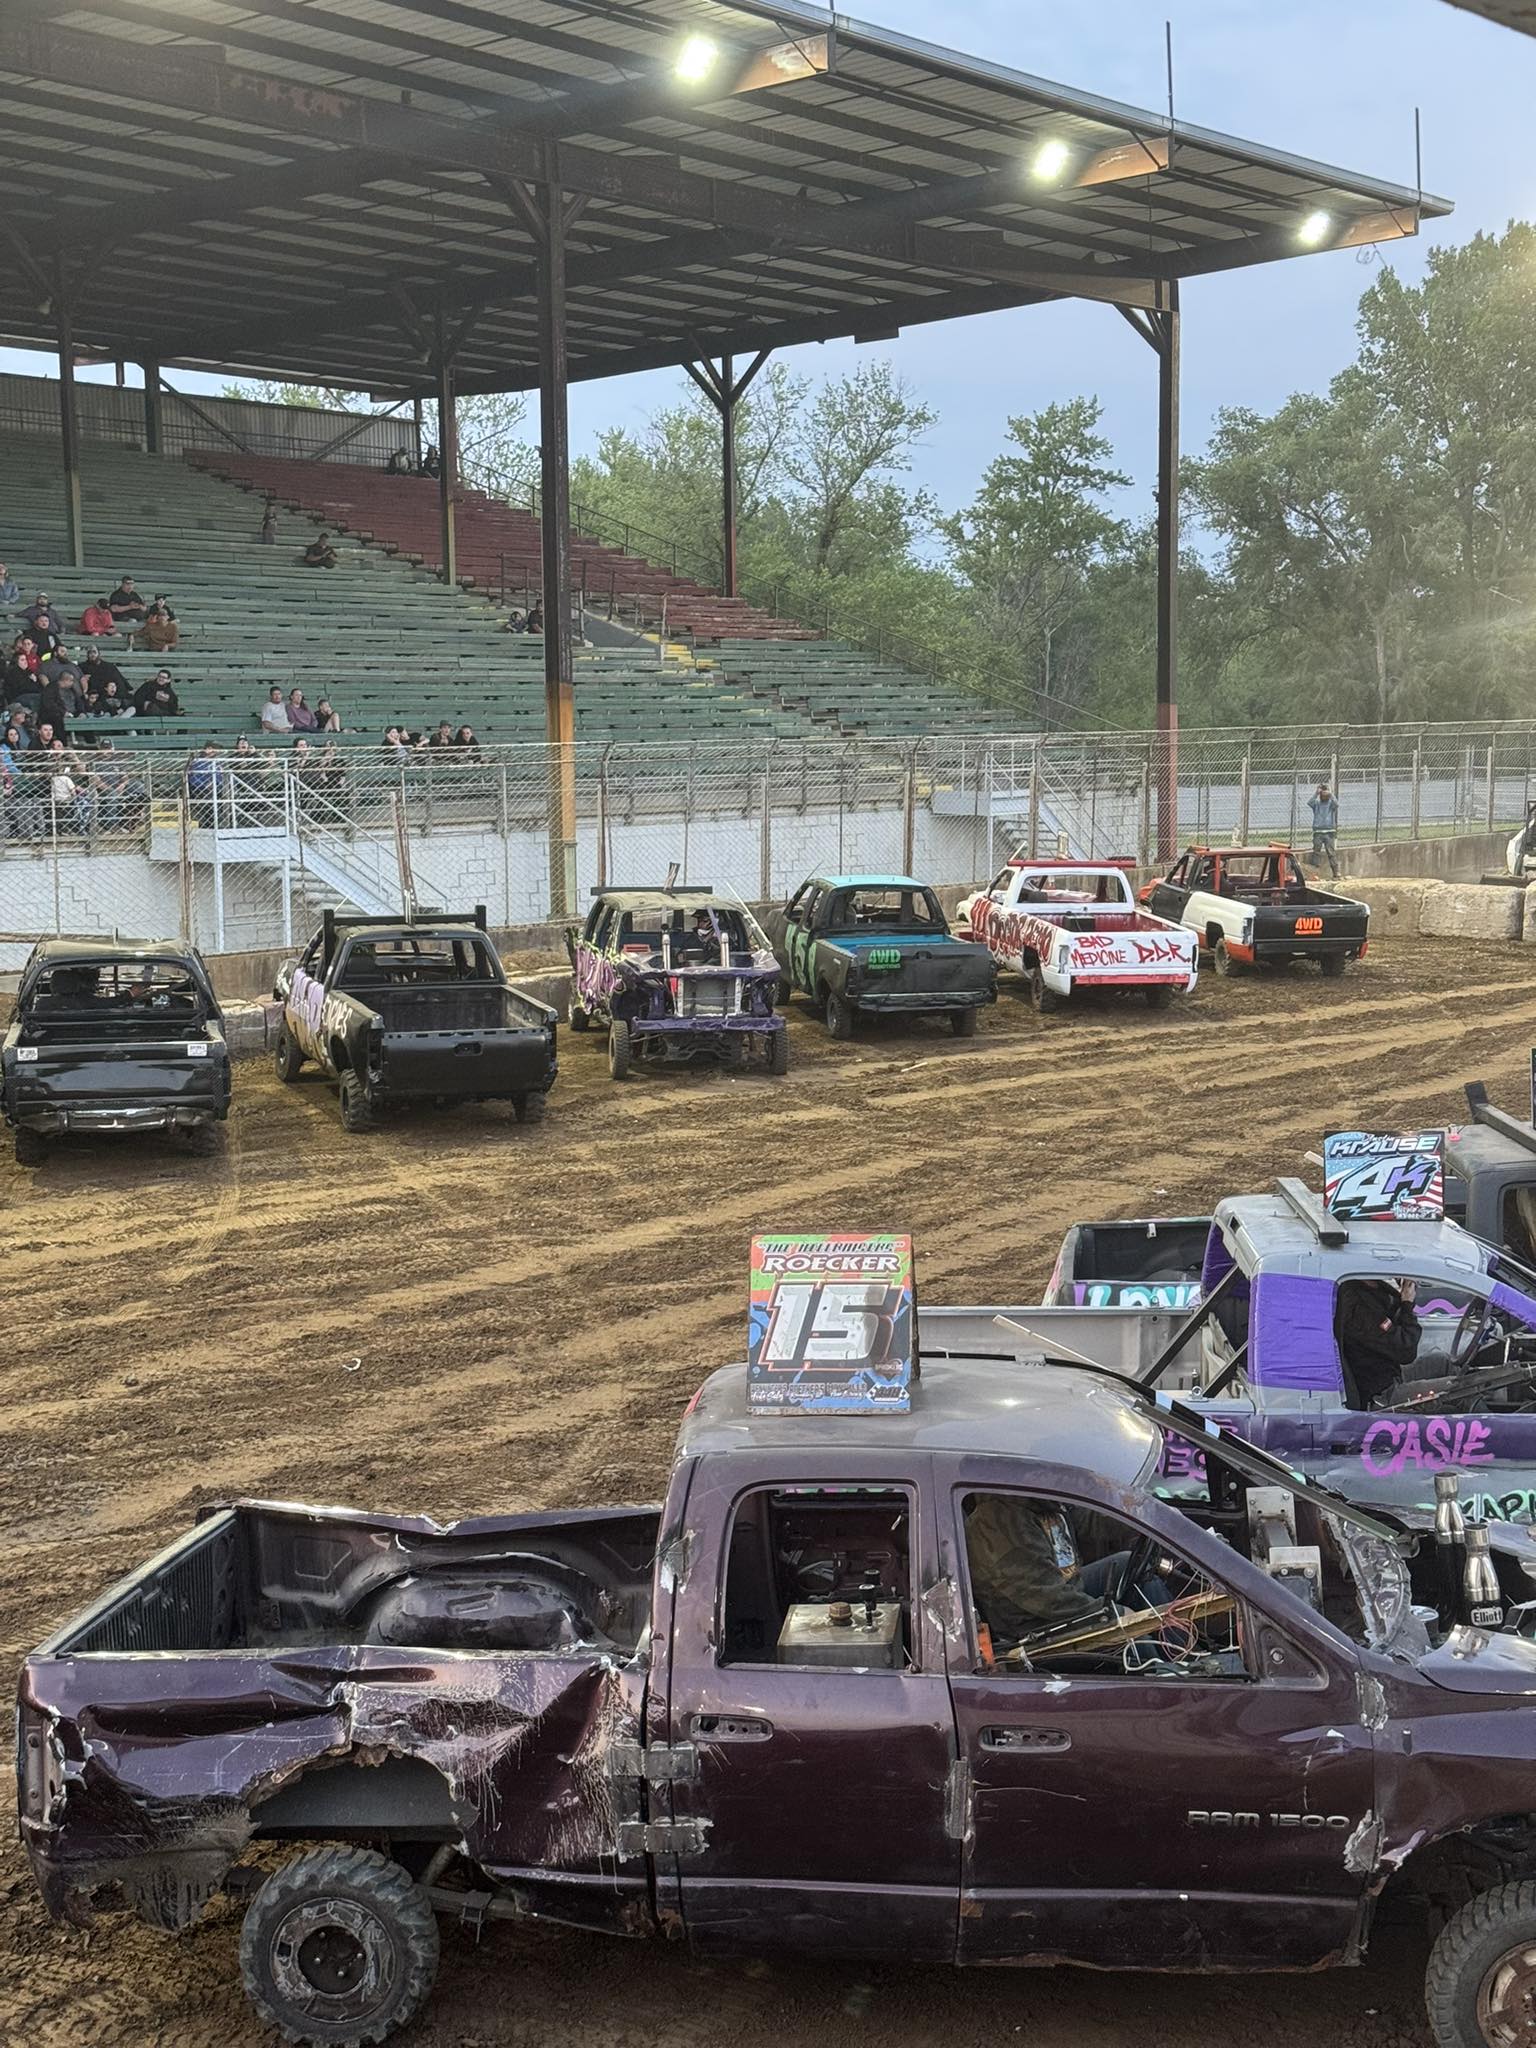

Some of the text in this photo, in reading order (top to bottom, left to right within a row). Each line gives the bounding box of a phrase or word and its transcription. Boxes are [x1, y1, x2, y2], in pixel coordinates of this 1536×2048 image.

[1295, 916, 1323, 930] 4WD
[1074, 936, 1114, 949] BAD
[868, 949, 901, 964] 4WD
[1071, 948, 1128, 968] MEDICINE
[1330, 1136, 1439, 1156] KRAUSE
[1331, 1155, 1438, 1209] 4K
[762, 1256, 899, 1272] ROECKER
[764, 1283, 892, 1362] 15
[1361, 1418, 1495, 1477] CASIE
[1188, 1811, 1350, 1828] RAM 1500
